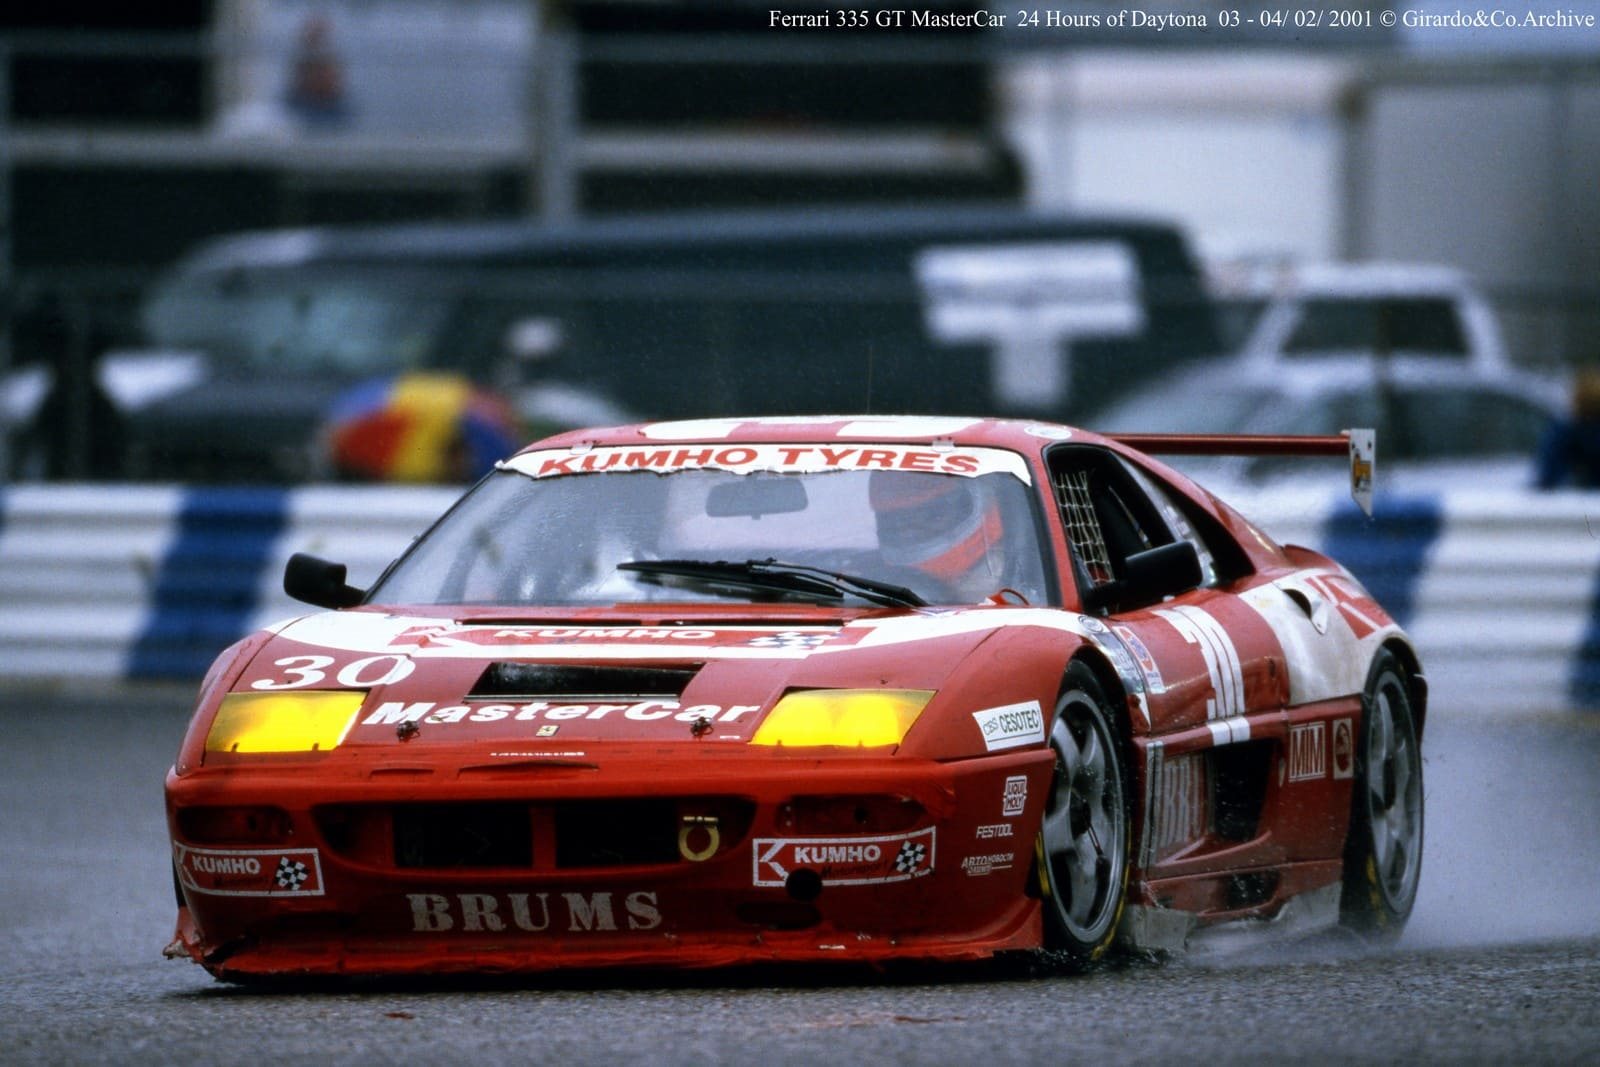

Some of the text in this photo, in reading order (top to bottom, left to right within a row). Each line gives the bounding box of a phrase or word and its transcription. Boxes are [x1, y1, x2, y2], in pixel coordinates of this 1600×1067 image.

[537, 447, 980, 476] KUMHO TYRES
[493, 629, 716, 640] KUMHO
[251, 655, 416, 689] 30
[361, 702, 760, 725] MasterCar
[999, 710, 1039, 734] CESOTEC
[976, 823, 1013, 839] FESTOOL
[192, 856, 261, 875] KUMHO
[794, 845, 881, 864] KUMHO
[406, 892, 663, 932] BRUMS
